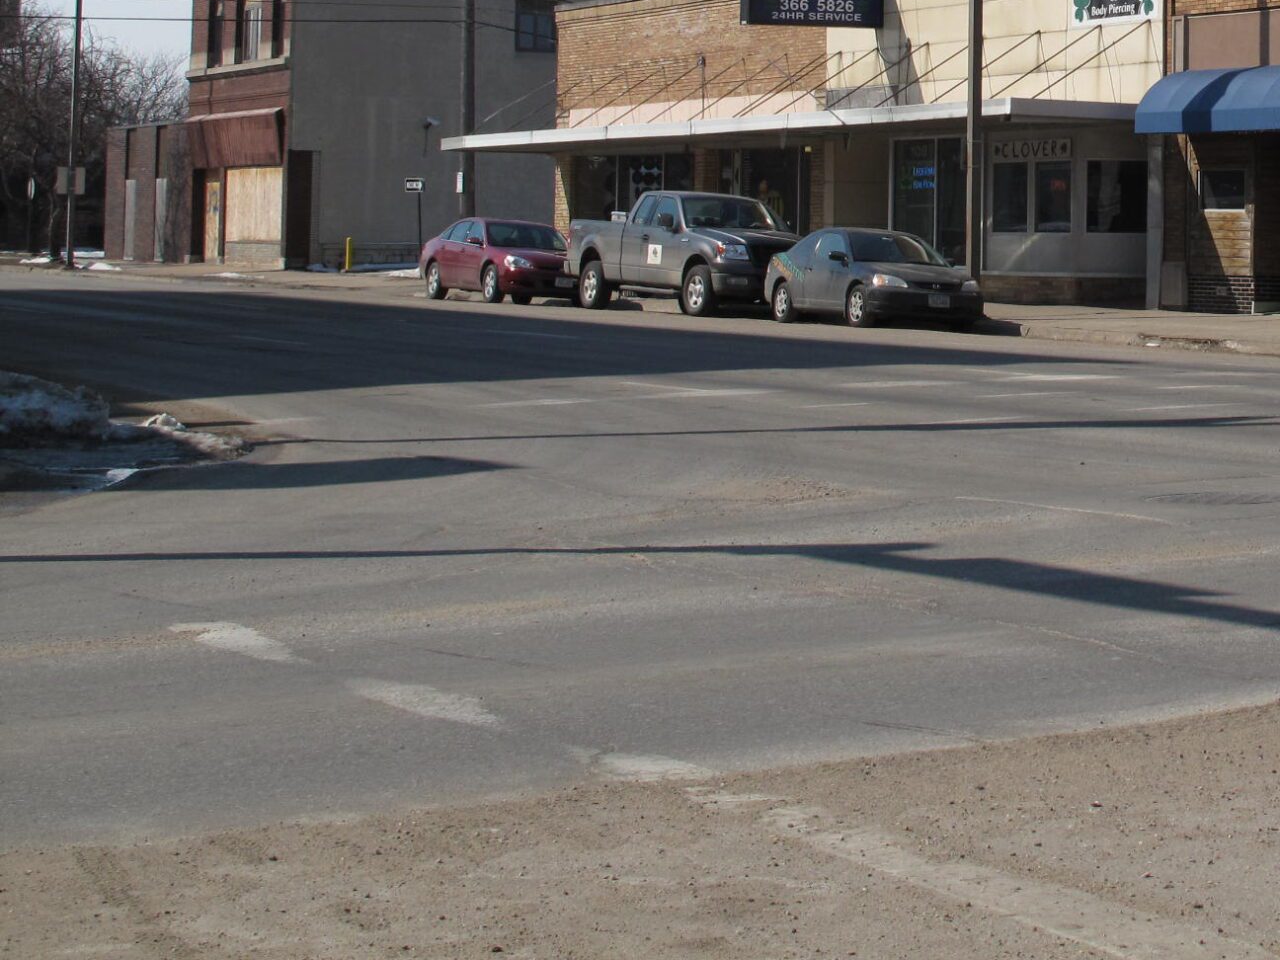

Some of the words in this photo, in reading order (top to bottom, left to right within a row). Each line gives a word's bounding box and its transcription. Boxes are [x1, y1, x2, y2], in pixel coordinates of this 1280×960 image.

[817, 0, 854, 12] 5826
[1091, 4, 1107, 18] Body
[1108, 1, 1135, 15] Piercing
[772, 11, 804, 20] 24HR
[808, 12, 862, 21] SERVICE
[1002, 140, 1057, 158] CLOVER
